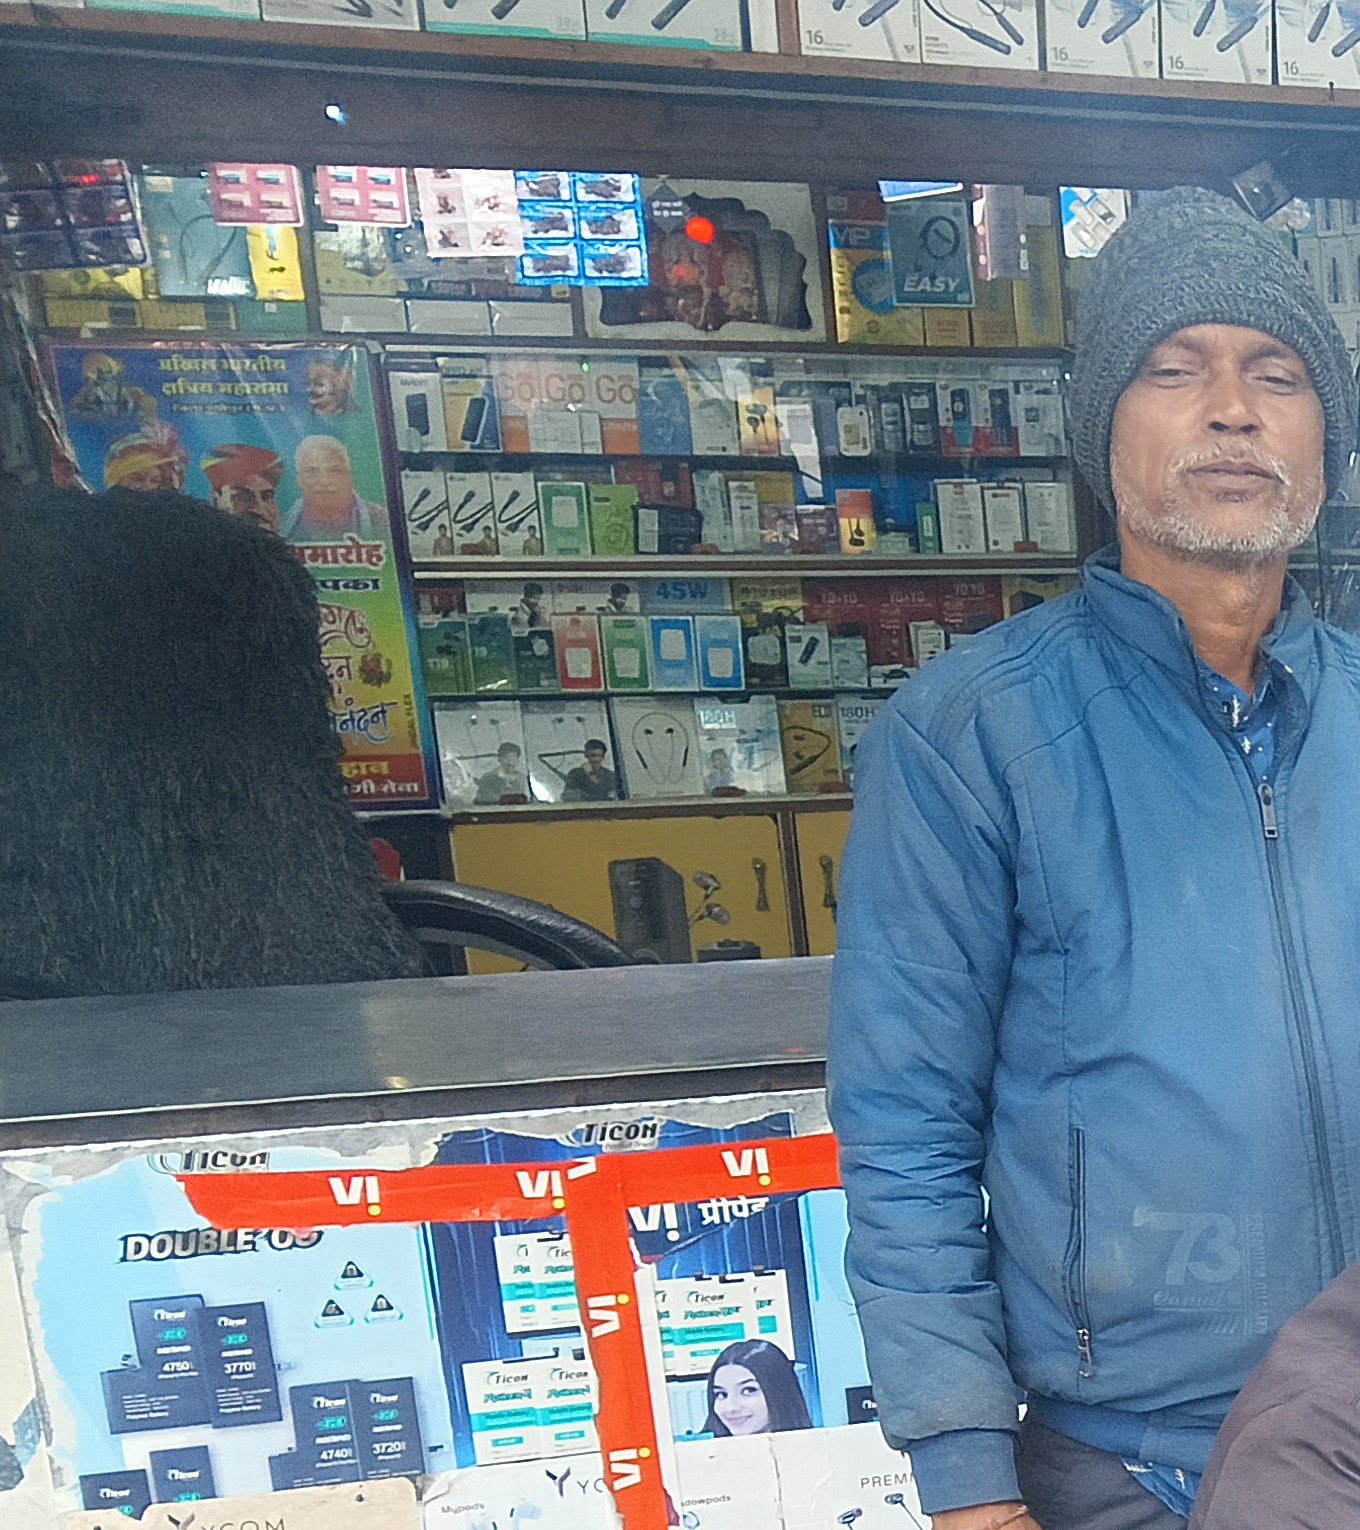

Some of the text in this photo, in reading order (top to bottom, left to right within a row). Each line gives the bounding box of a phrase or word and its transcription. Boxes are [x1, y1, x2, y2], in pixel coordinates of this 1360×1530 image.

[805, 29, 824, 46] 16
[1052, 46, 1068, 62] 16
[1168, 55, 1184, 71] 16
[1283, 61, 1299, 76] 16
[904, 276, 960, 293] EASY
[656, 582, 709, 600] 45W
[124, 1228, 256, 1262] DOUBLE
[577, 1478, 604, 1494] YC
[861, 1473, 914, 1489] PREM
[442, 1502, 485, 1515] Mypods
